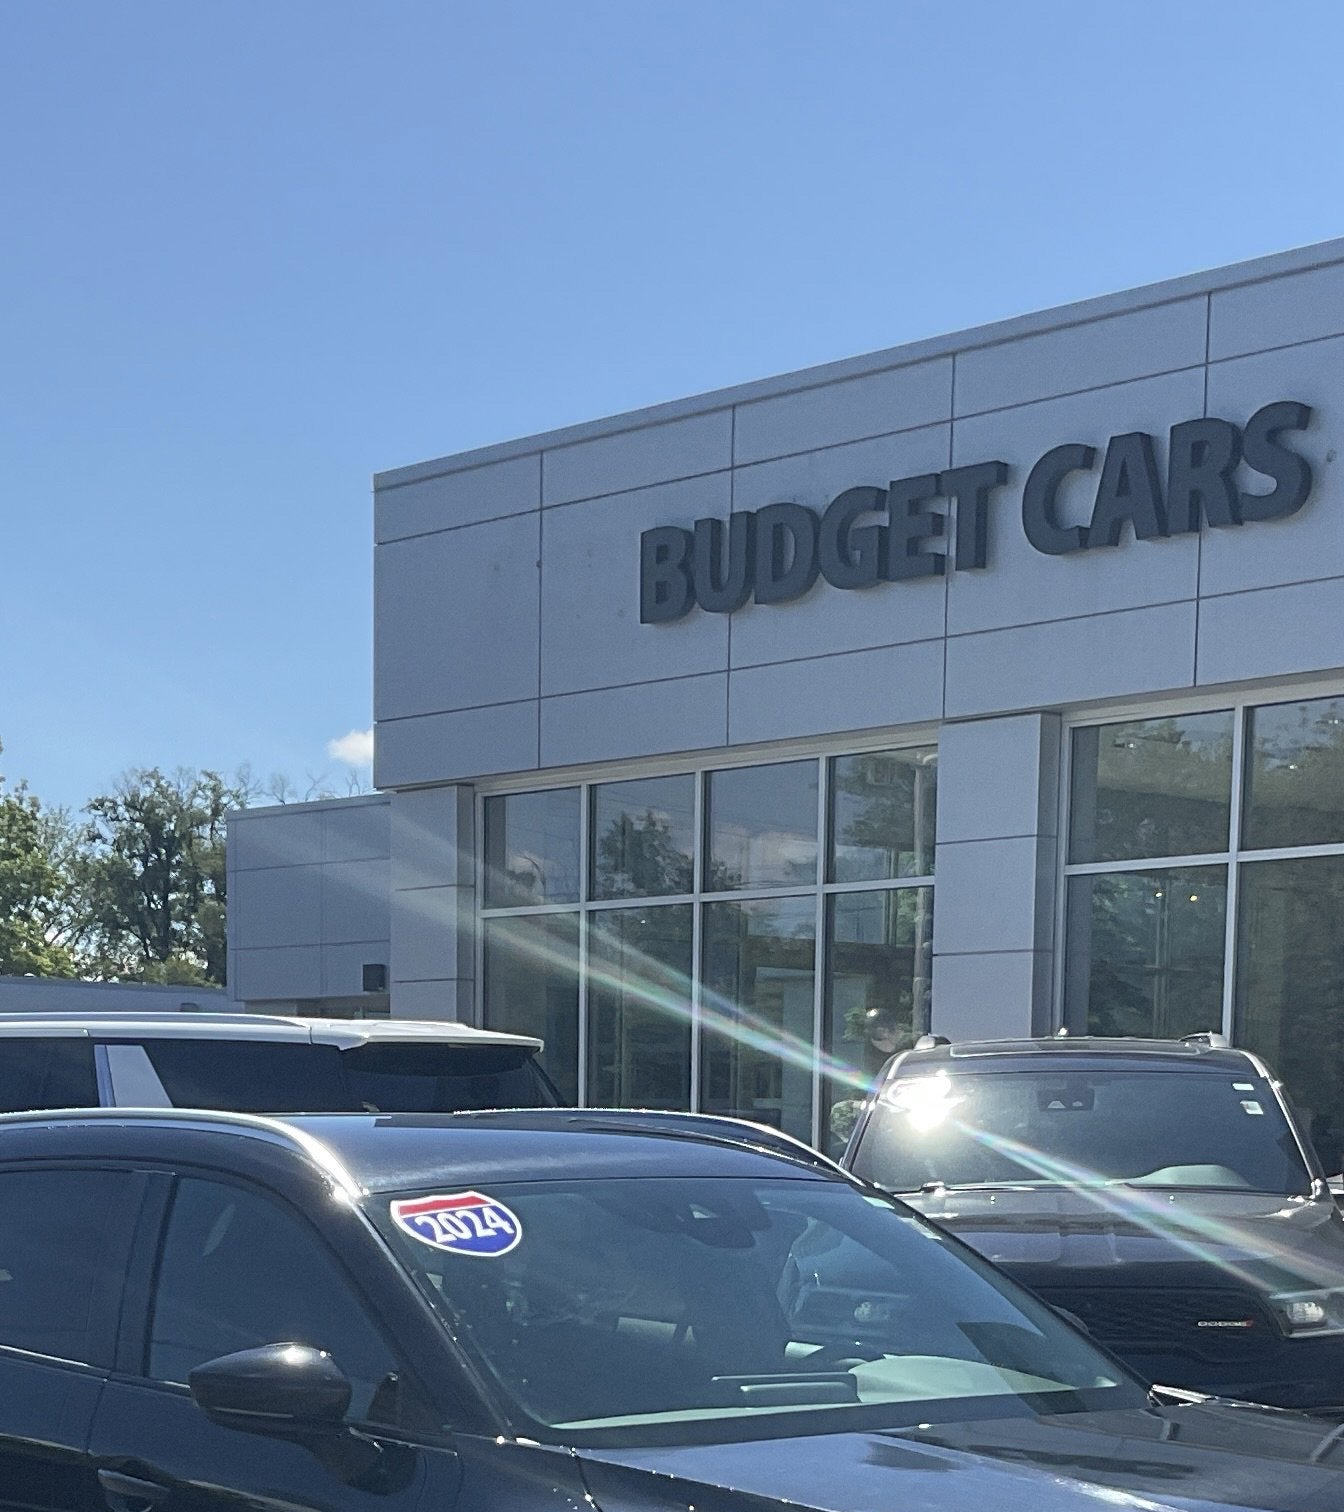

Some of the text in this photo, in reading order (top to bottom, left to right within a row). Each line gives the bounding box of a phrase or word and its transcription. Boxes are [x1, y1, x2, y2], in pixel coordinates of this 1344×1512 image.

[640, 401, 1313, 624] BUDGET CARS
[414, 1206, 514, 1243] 2024
